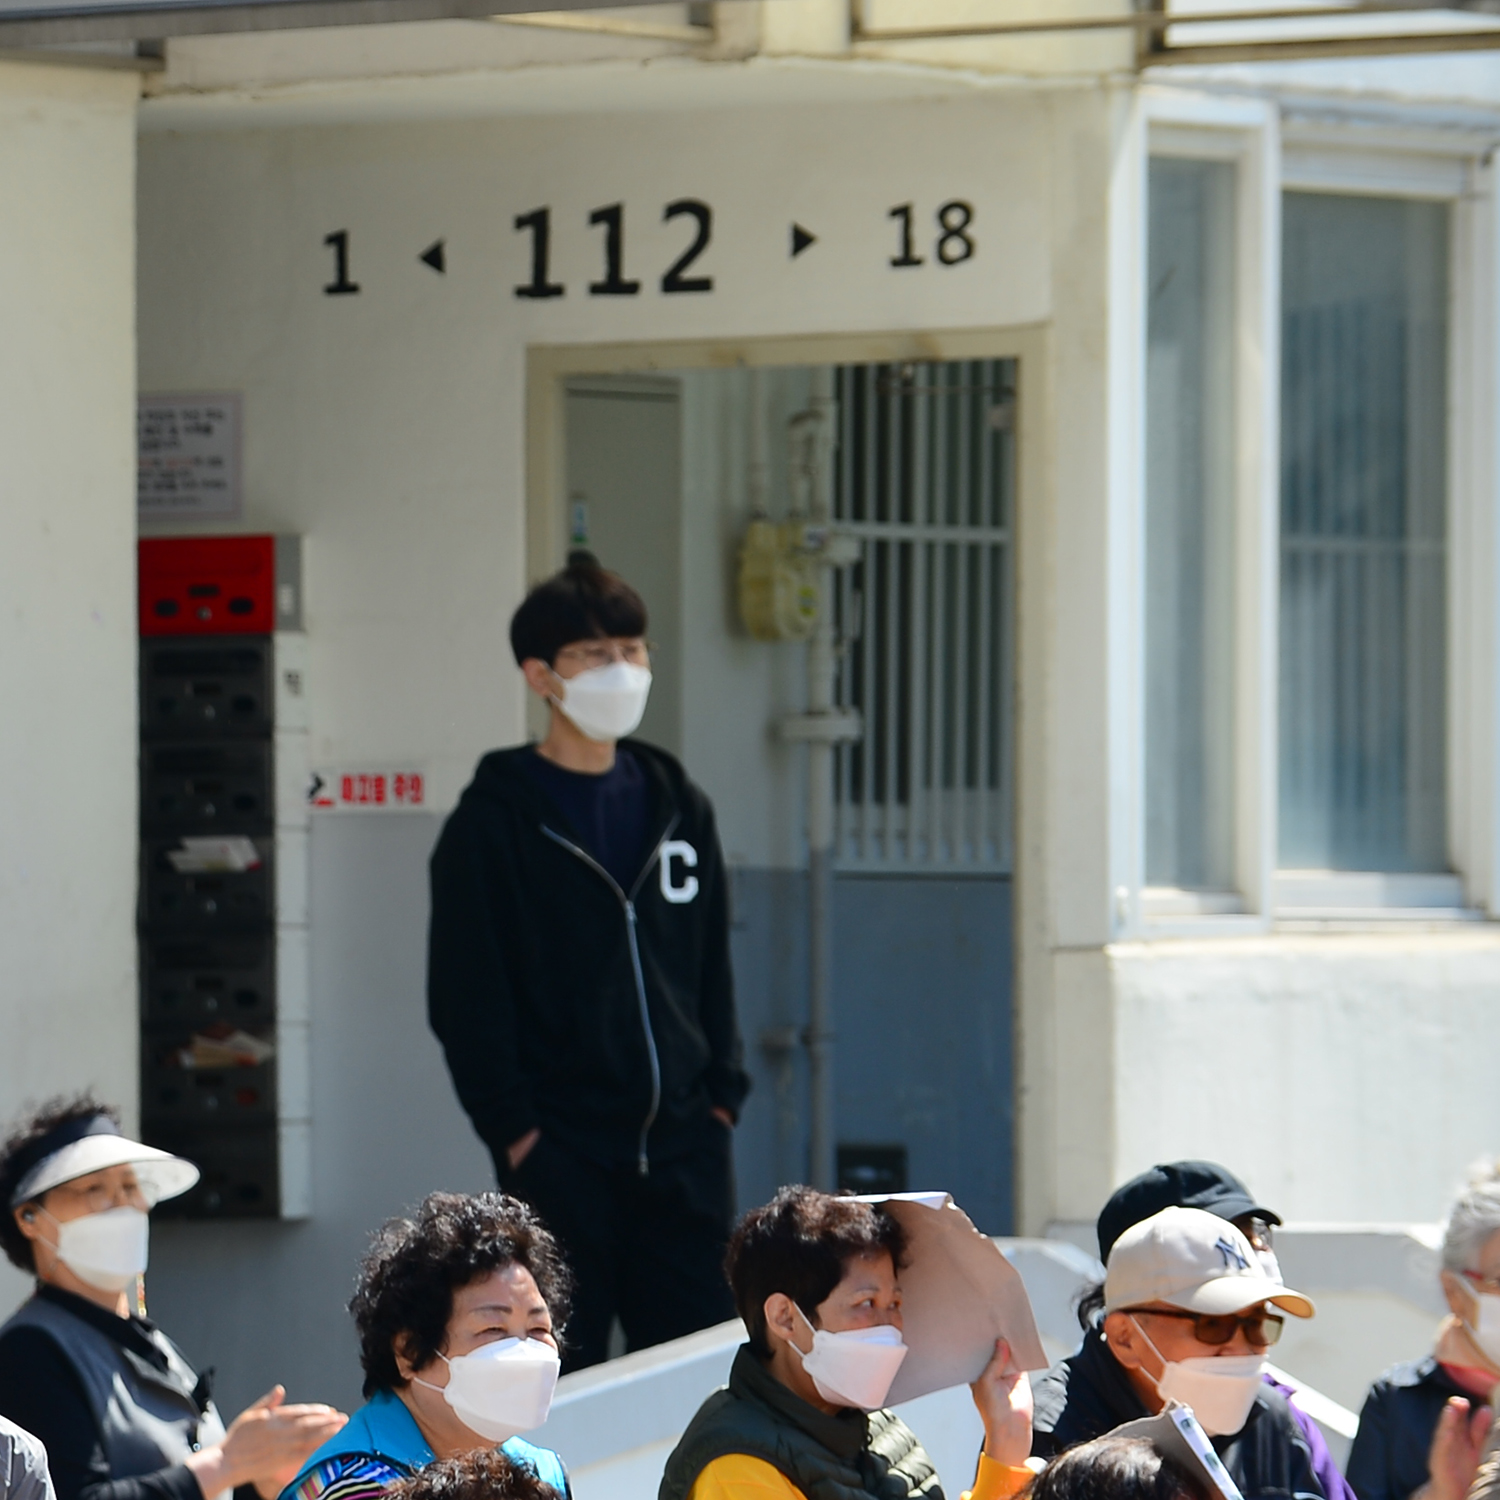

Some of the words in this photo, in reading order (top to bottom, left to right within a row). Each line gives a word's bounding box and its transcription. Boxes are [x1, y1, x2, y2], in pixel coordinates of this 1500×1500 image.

[321, 228, 361, 296] 1
[512, 199, 714, 300] 112
[887, 201, 976, 268] 18
[659, 840, 699, 904] C
[1215, 1236, 1251, 1270] NY
